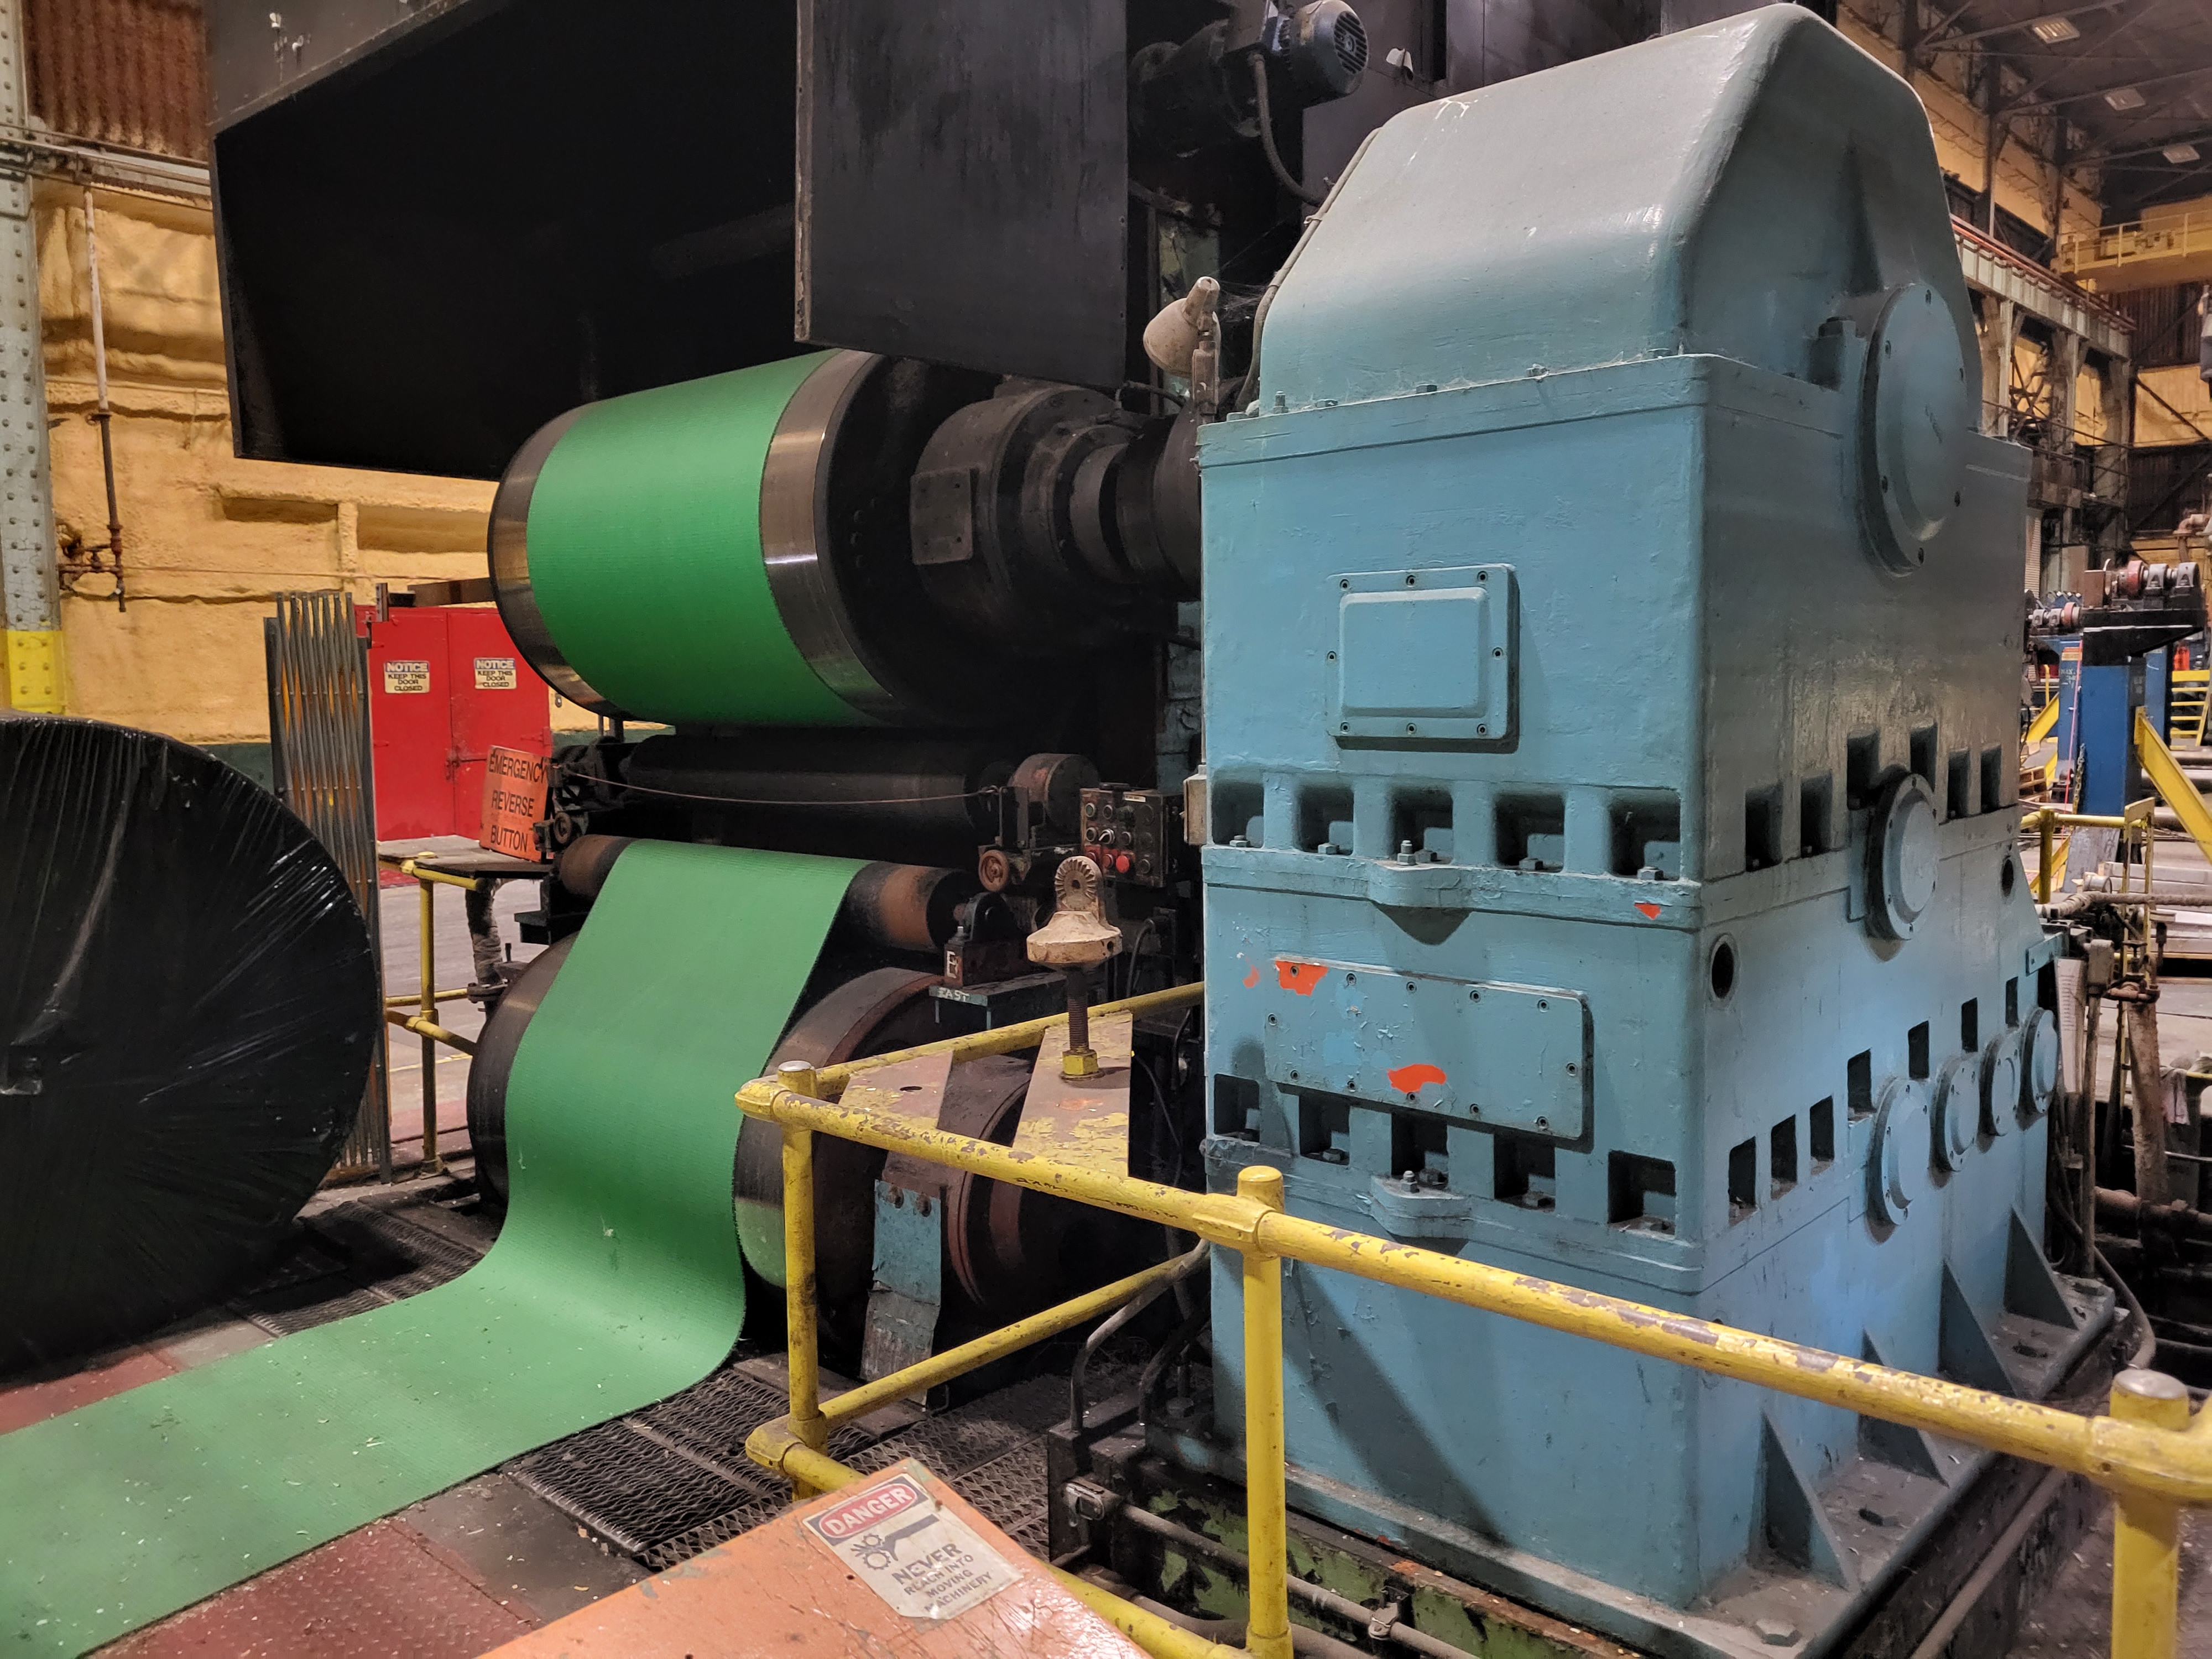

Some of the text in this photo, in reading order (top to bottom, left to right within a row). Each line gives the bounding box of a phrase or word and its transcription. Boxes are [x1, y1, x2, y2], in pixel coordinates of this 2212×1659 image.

[387, 662, 428, 672] NOTICE
[476, 660, 514, 669] NOTICE
[489, 754, 548, 783] EMERGENCY
[491, 790, 535, 817] REVERSE
[491, 825, 528, 852] BUTTON
[937, 987, 970, 1002] EAST
[825, 1488, 913, 1535] DANGER
[891, 1543, 963, 1585] NEVER
[904, 1554, 974, 1595] REACH INTO
[924, 1571, 992, 1613] MACHINERY
[925, 1569, 974, 1598] MOVING
